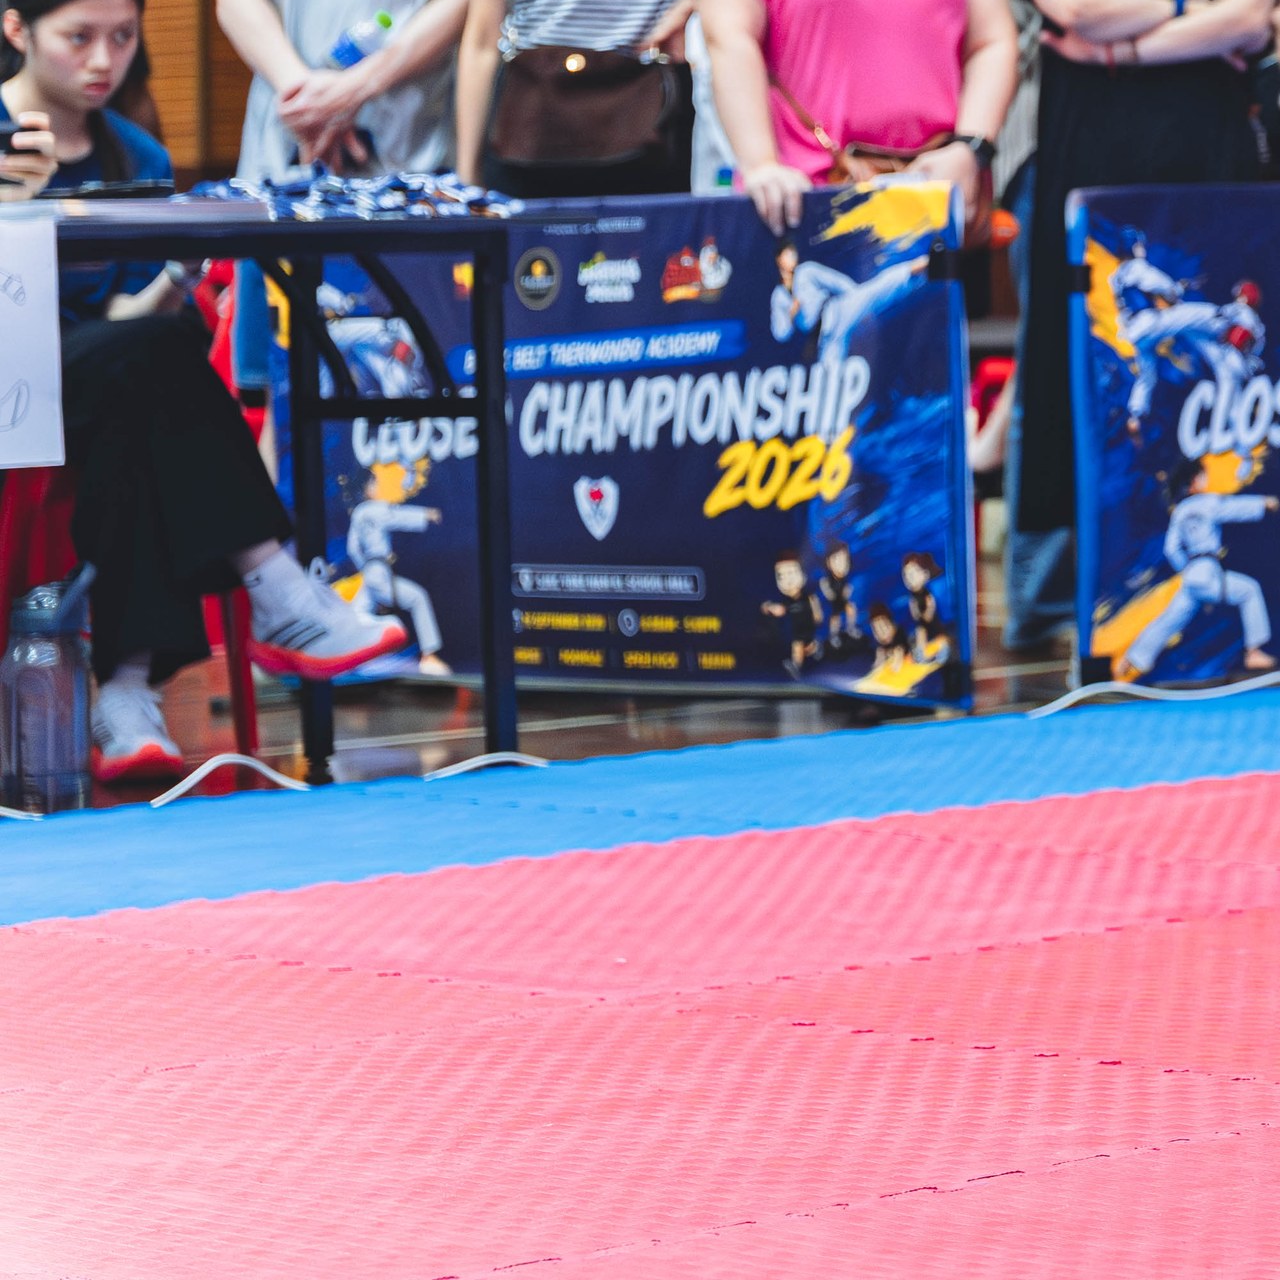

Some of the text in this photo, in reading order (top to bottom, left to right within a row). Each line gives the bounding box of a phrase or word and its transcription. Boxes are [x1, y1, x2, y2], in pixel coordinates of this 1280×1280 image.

[548, 336, 645, 368] TAEKWONDO
[644, 329, 721, 361] ACADEMY
[519, 354, 871, 458] CHAMPIONSHIP
[703, 423, 855, 519] 2026
